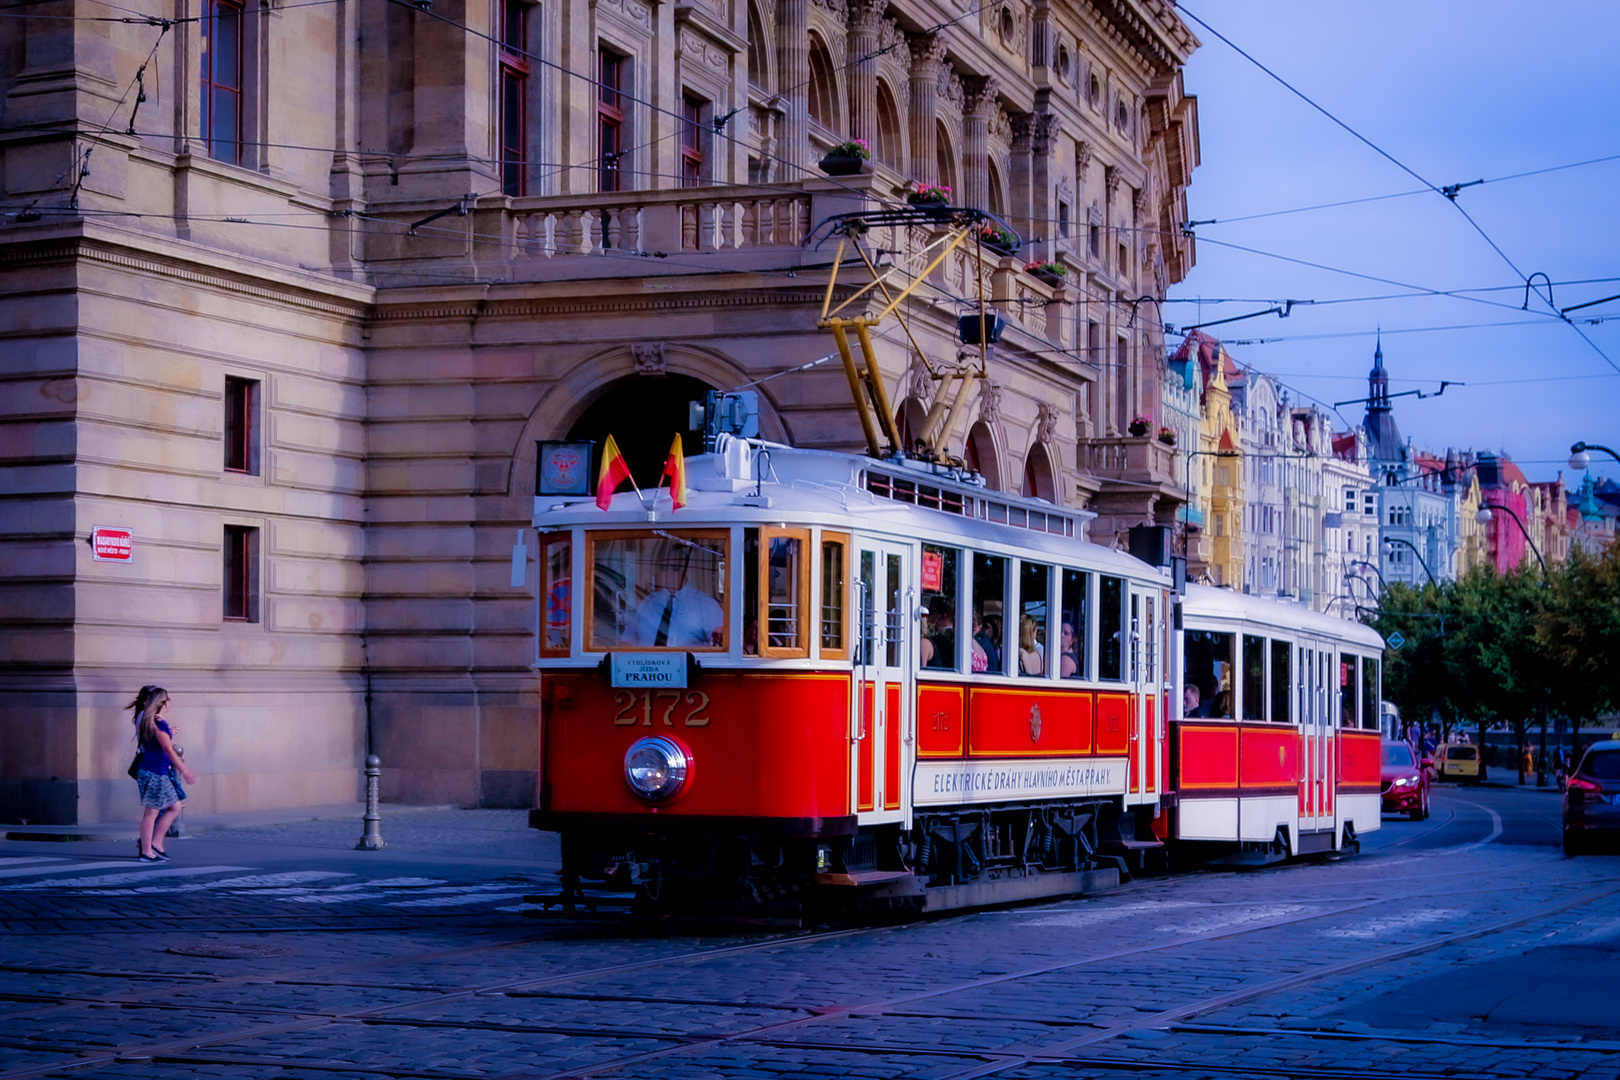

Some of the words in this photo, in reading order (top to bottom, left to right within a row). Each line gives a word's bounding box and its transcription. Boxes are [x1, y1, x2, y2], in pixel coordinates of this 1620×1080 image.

[625, 673, 673, 681] PRAHOU
[614, 690, 710, 726] 2172
[932, 711, 950, 731] 2172
[934, 769, 993, 793] ELEKTRICKÉ
[994, 768, 1023, 790] DRÁHY
[1023, 767, 1058, 789] HLAVNÍHO
[1059, 766, 1085, 787] MĚSTA
